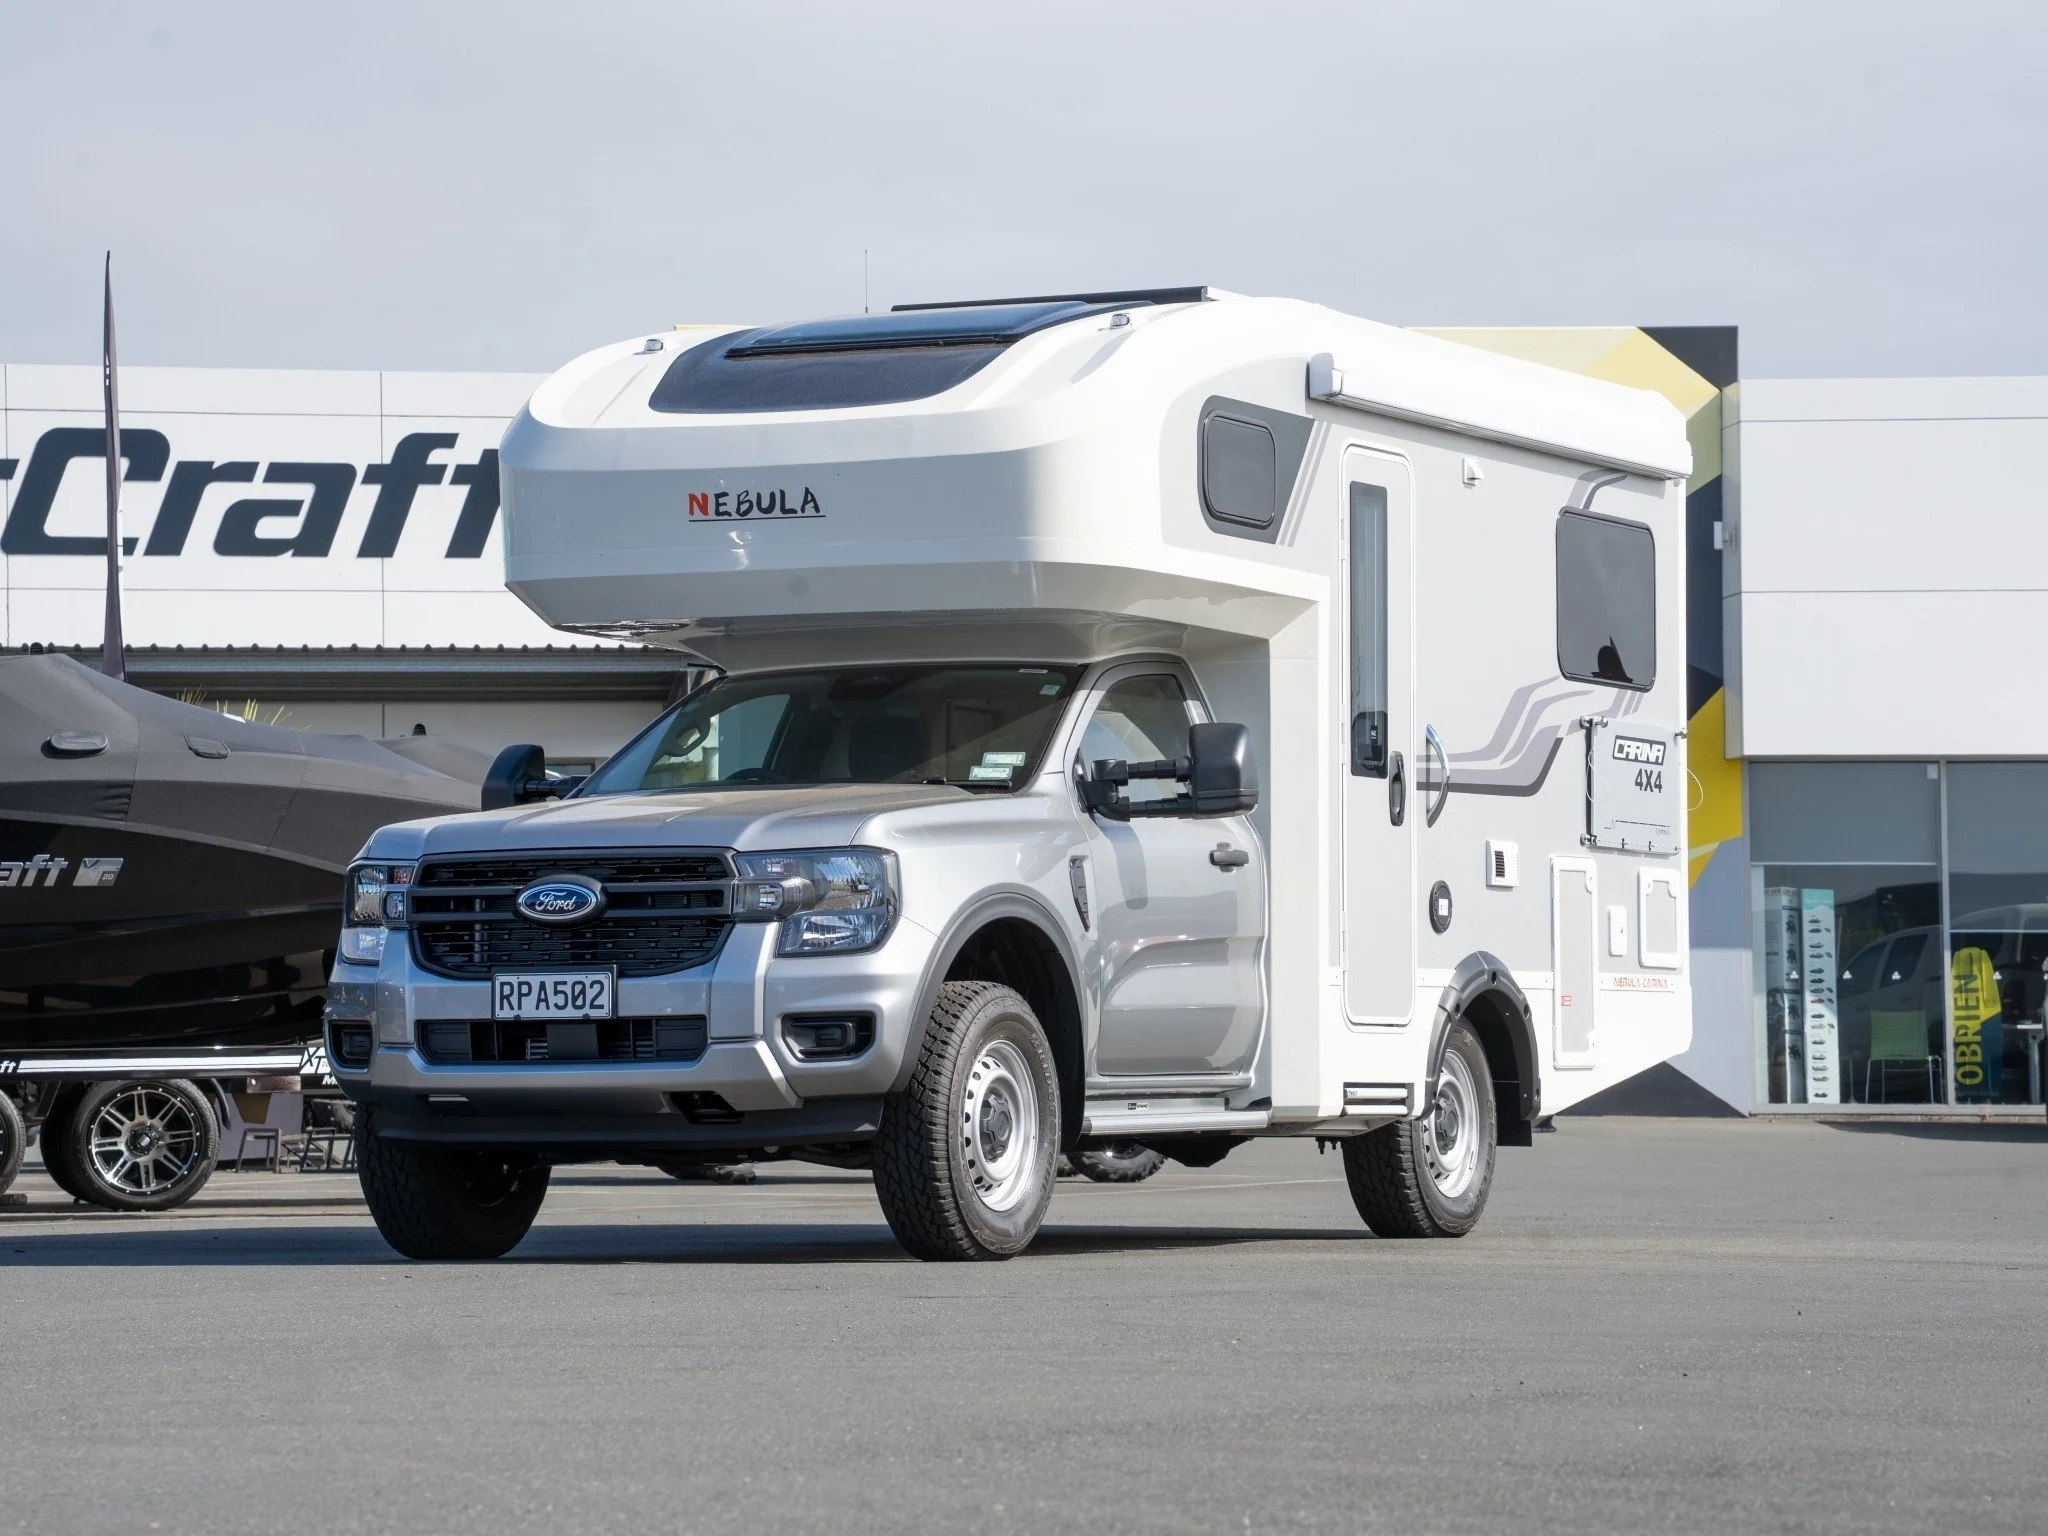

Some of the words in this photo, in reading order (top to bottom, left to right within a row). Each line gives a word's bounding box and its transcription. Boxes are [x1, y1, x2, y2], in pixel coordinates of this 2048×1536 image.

[688, 487, 821, 518] NEBULA
[1613, 739, 1665, 763] CARINA
[1634, 768, 1662, 793] 4X4
[534, 890, 576, 911] Ford
[499, 979, 605, 1011] RPA502
[1953, 974, 1984, 1086] OBRIEN
